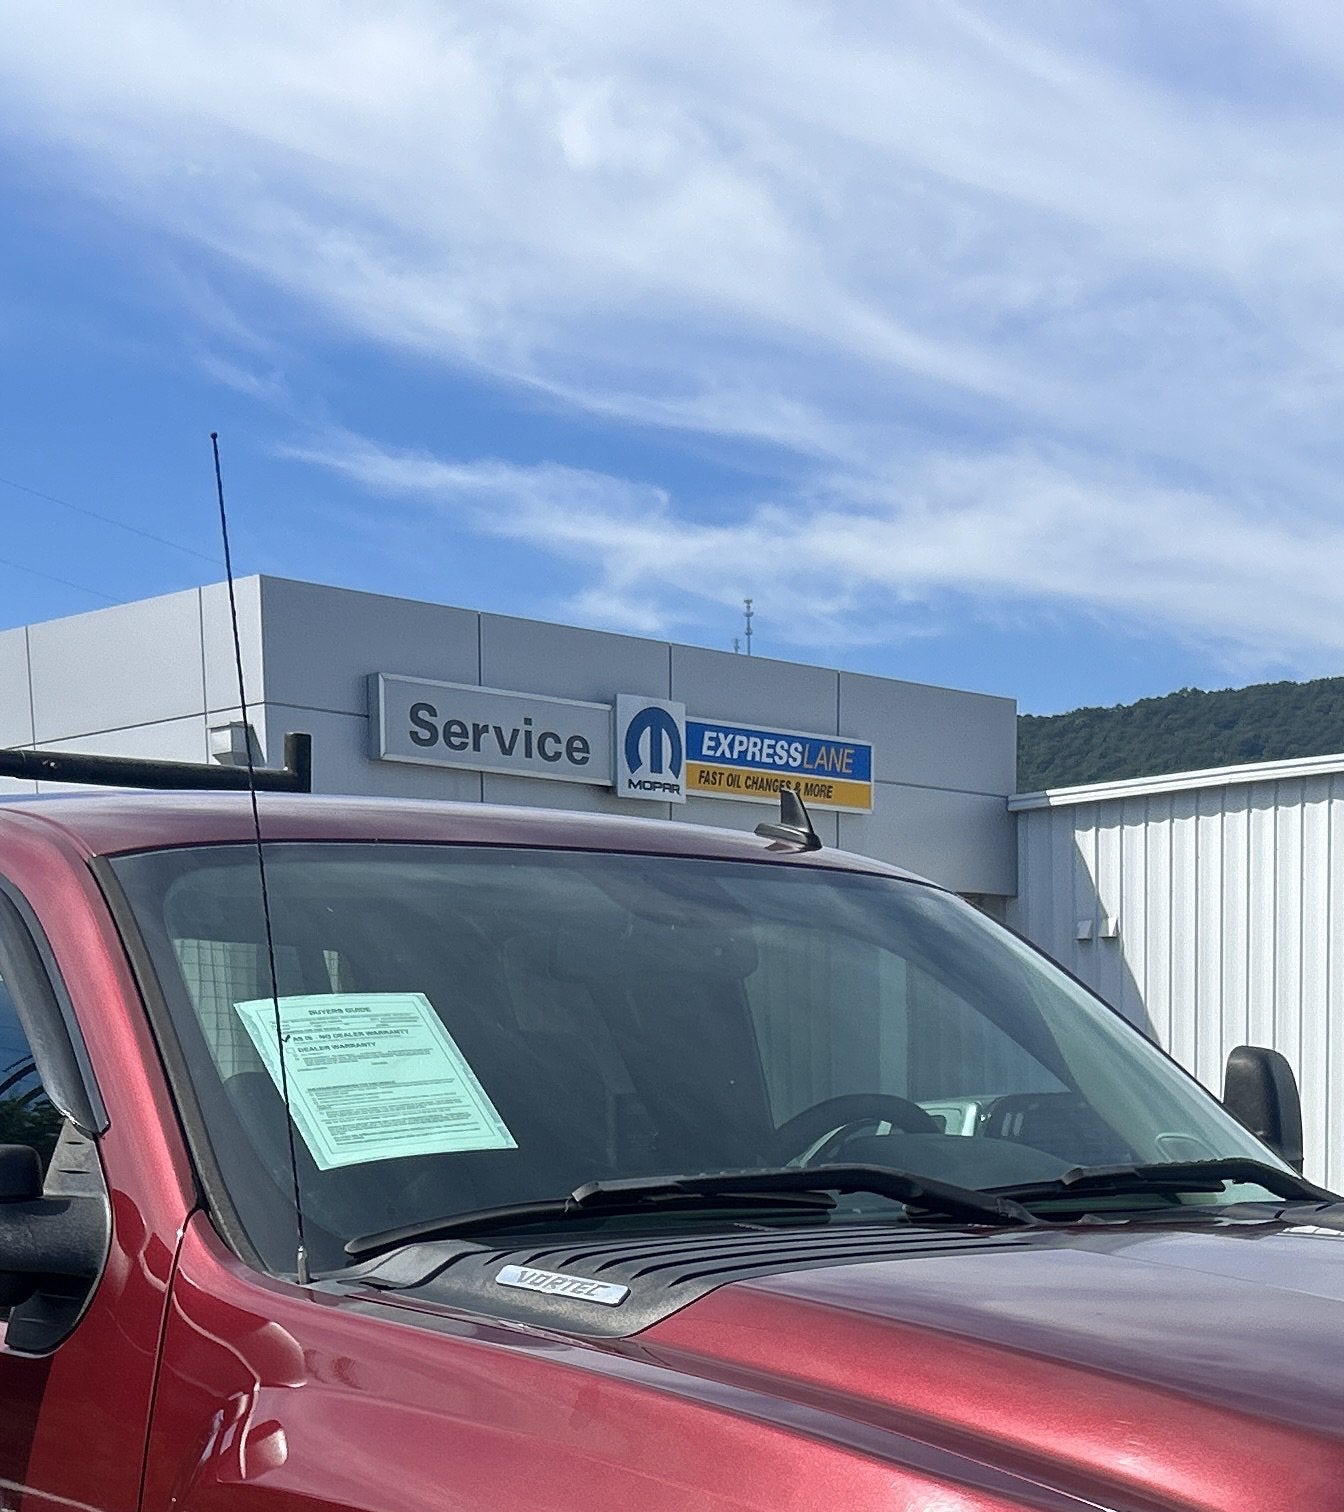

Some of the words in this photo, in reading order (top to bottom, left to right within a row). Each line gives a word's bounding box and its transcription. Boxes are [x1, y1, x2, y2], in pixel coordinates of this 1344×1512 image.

[409, 702, 591, 766] Service
[627, 778, 681, 796] MOPAR
[698, 769, 724, 787] FAST
[726, 772, 742, 789] OIL
[744, 775, 792, 793] CHANGES
[804, 782, 834, 799] MORE
[517, 1269, 612, 1297] VORTEC
